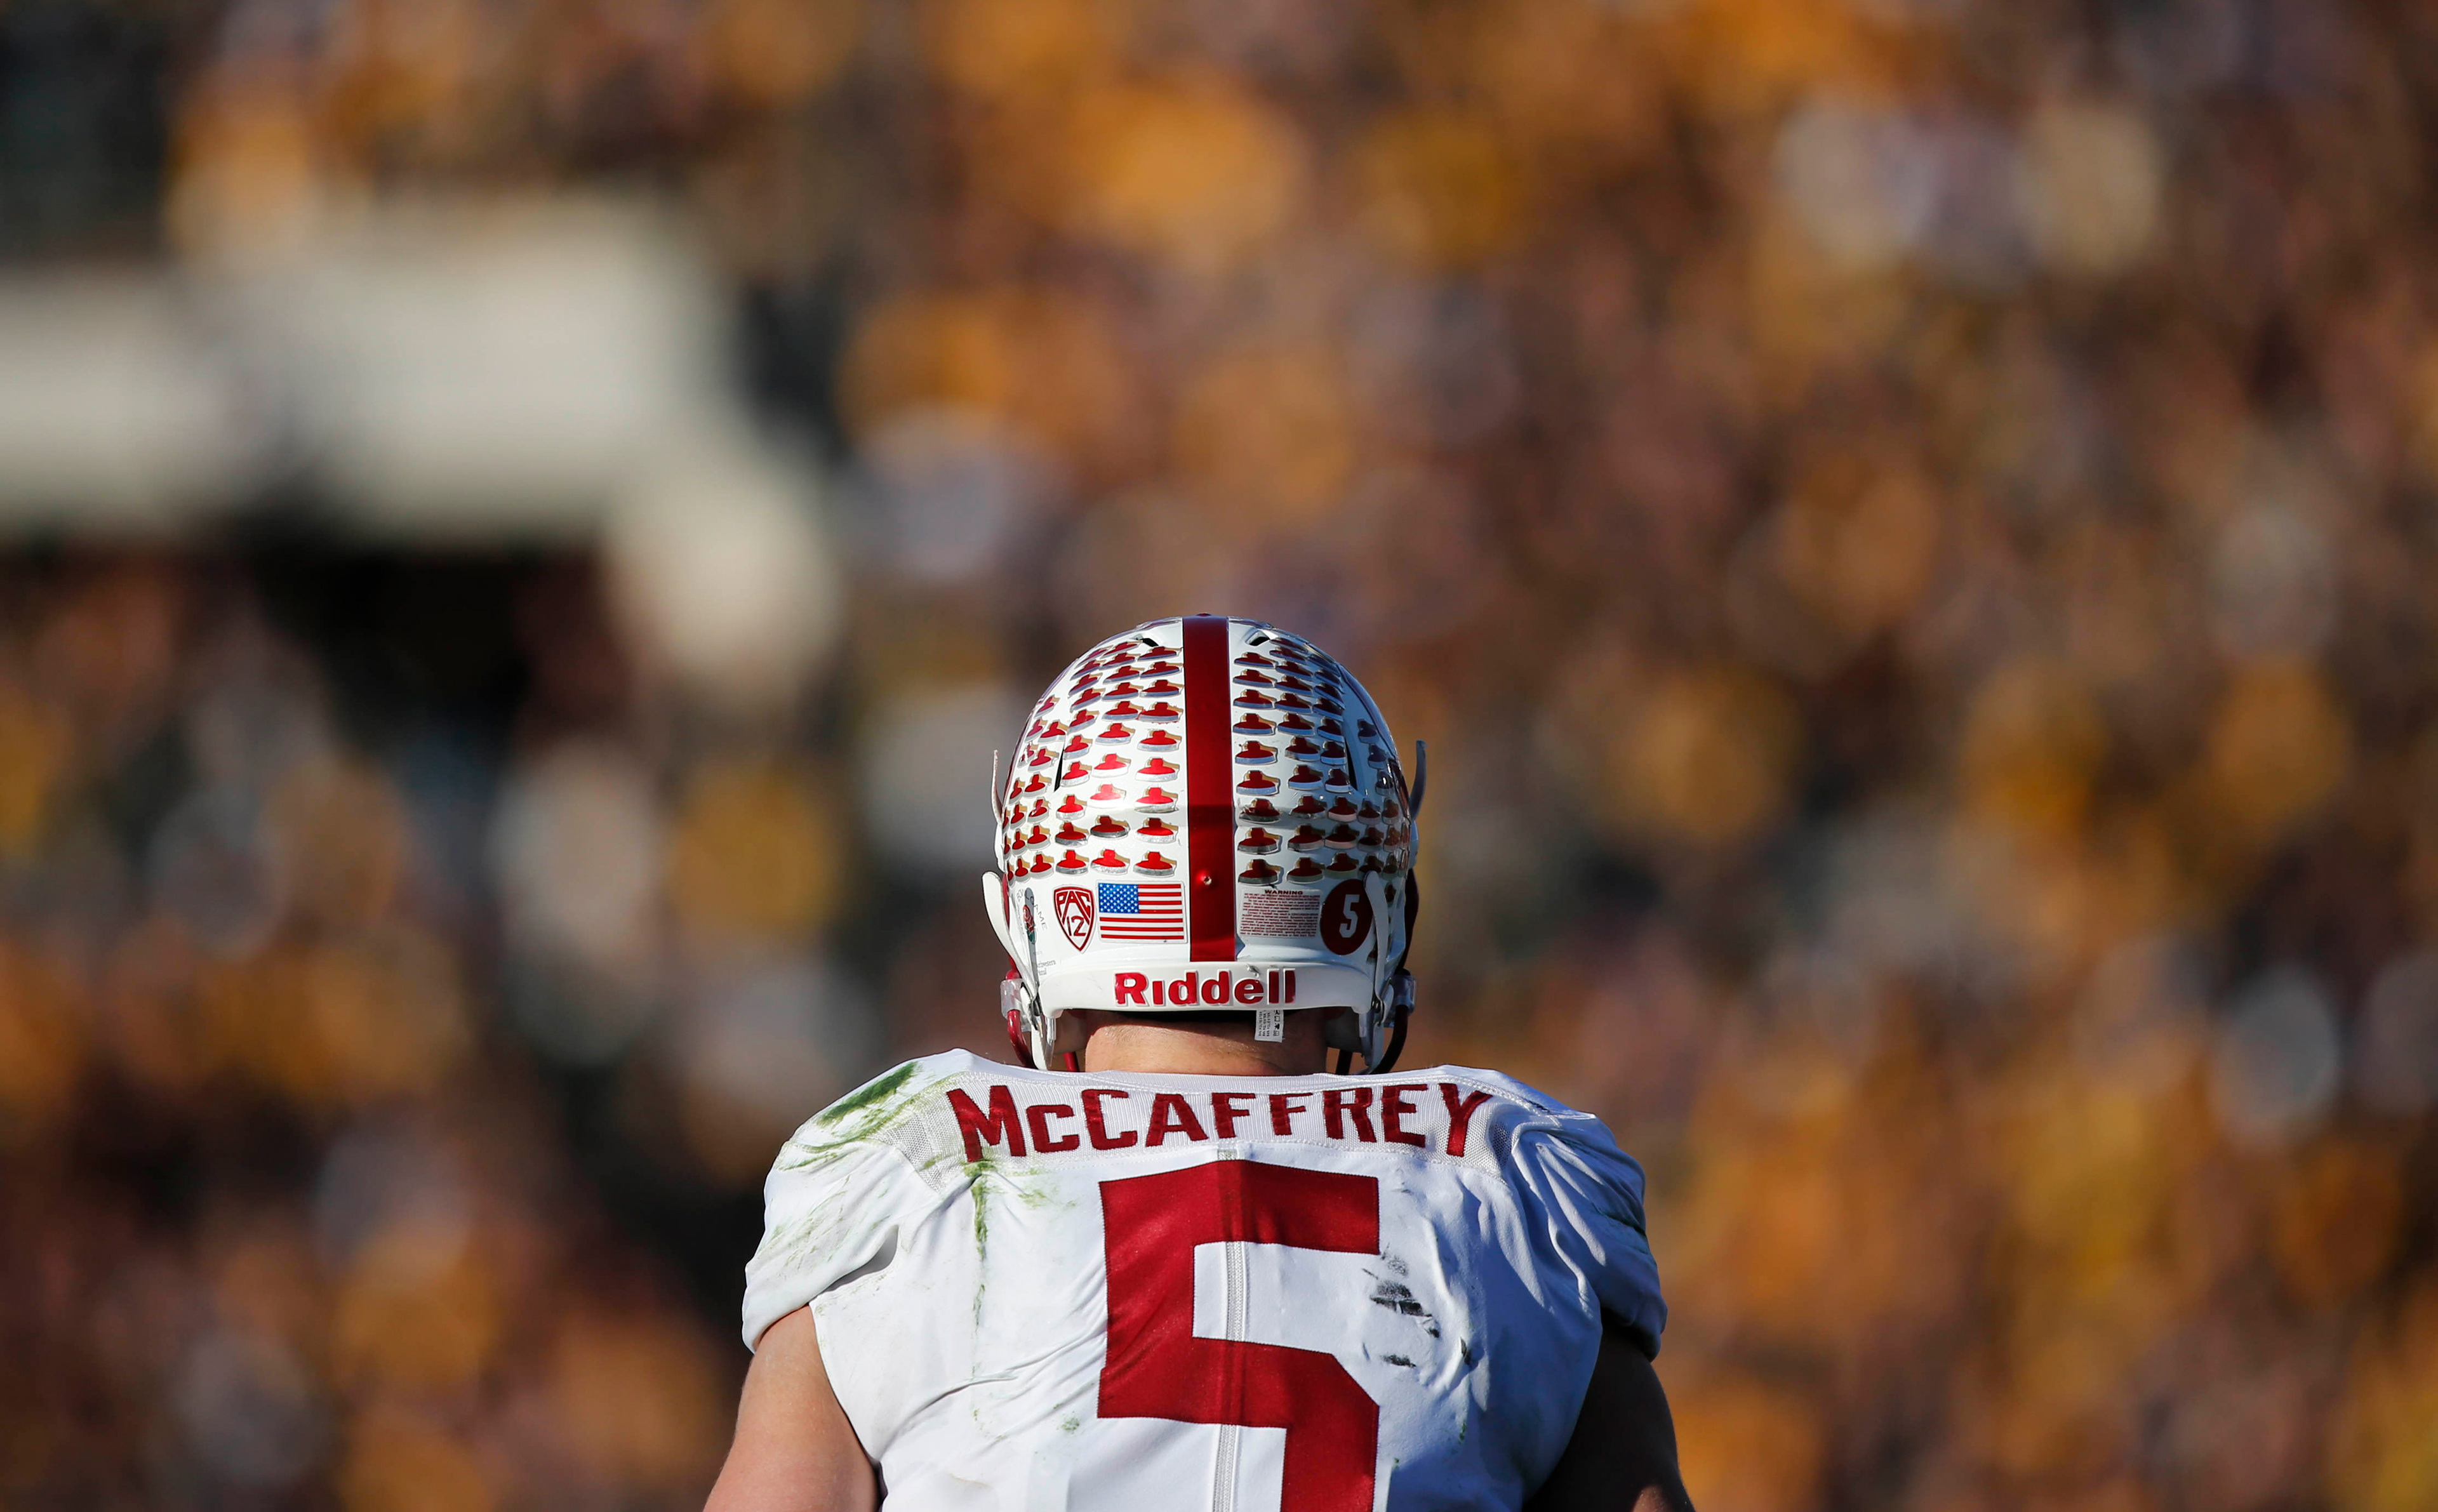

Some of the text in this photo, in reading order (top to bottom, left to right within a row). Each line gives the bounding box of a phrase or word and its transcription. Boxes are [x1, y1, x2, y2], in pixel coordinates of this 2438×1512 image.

[1056, 891, 1091, 925] PAC
[1067, 915, 1086, 936] 12
[1339, 894, 1360, 938] 5
[1114, 968, 1296, 1005] Riddell
[945, 1082, 1492, 1162] McCAFFREY
[1097, 1159, 1381, 1512] 5
